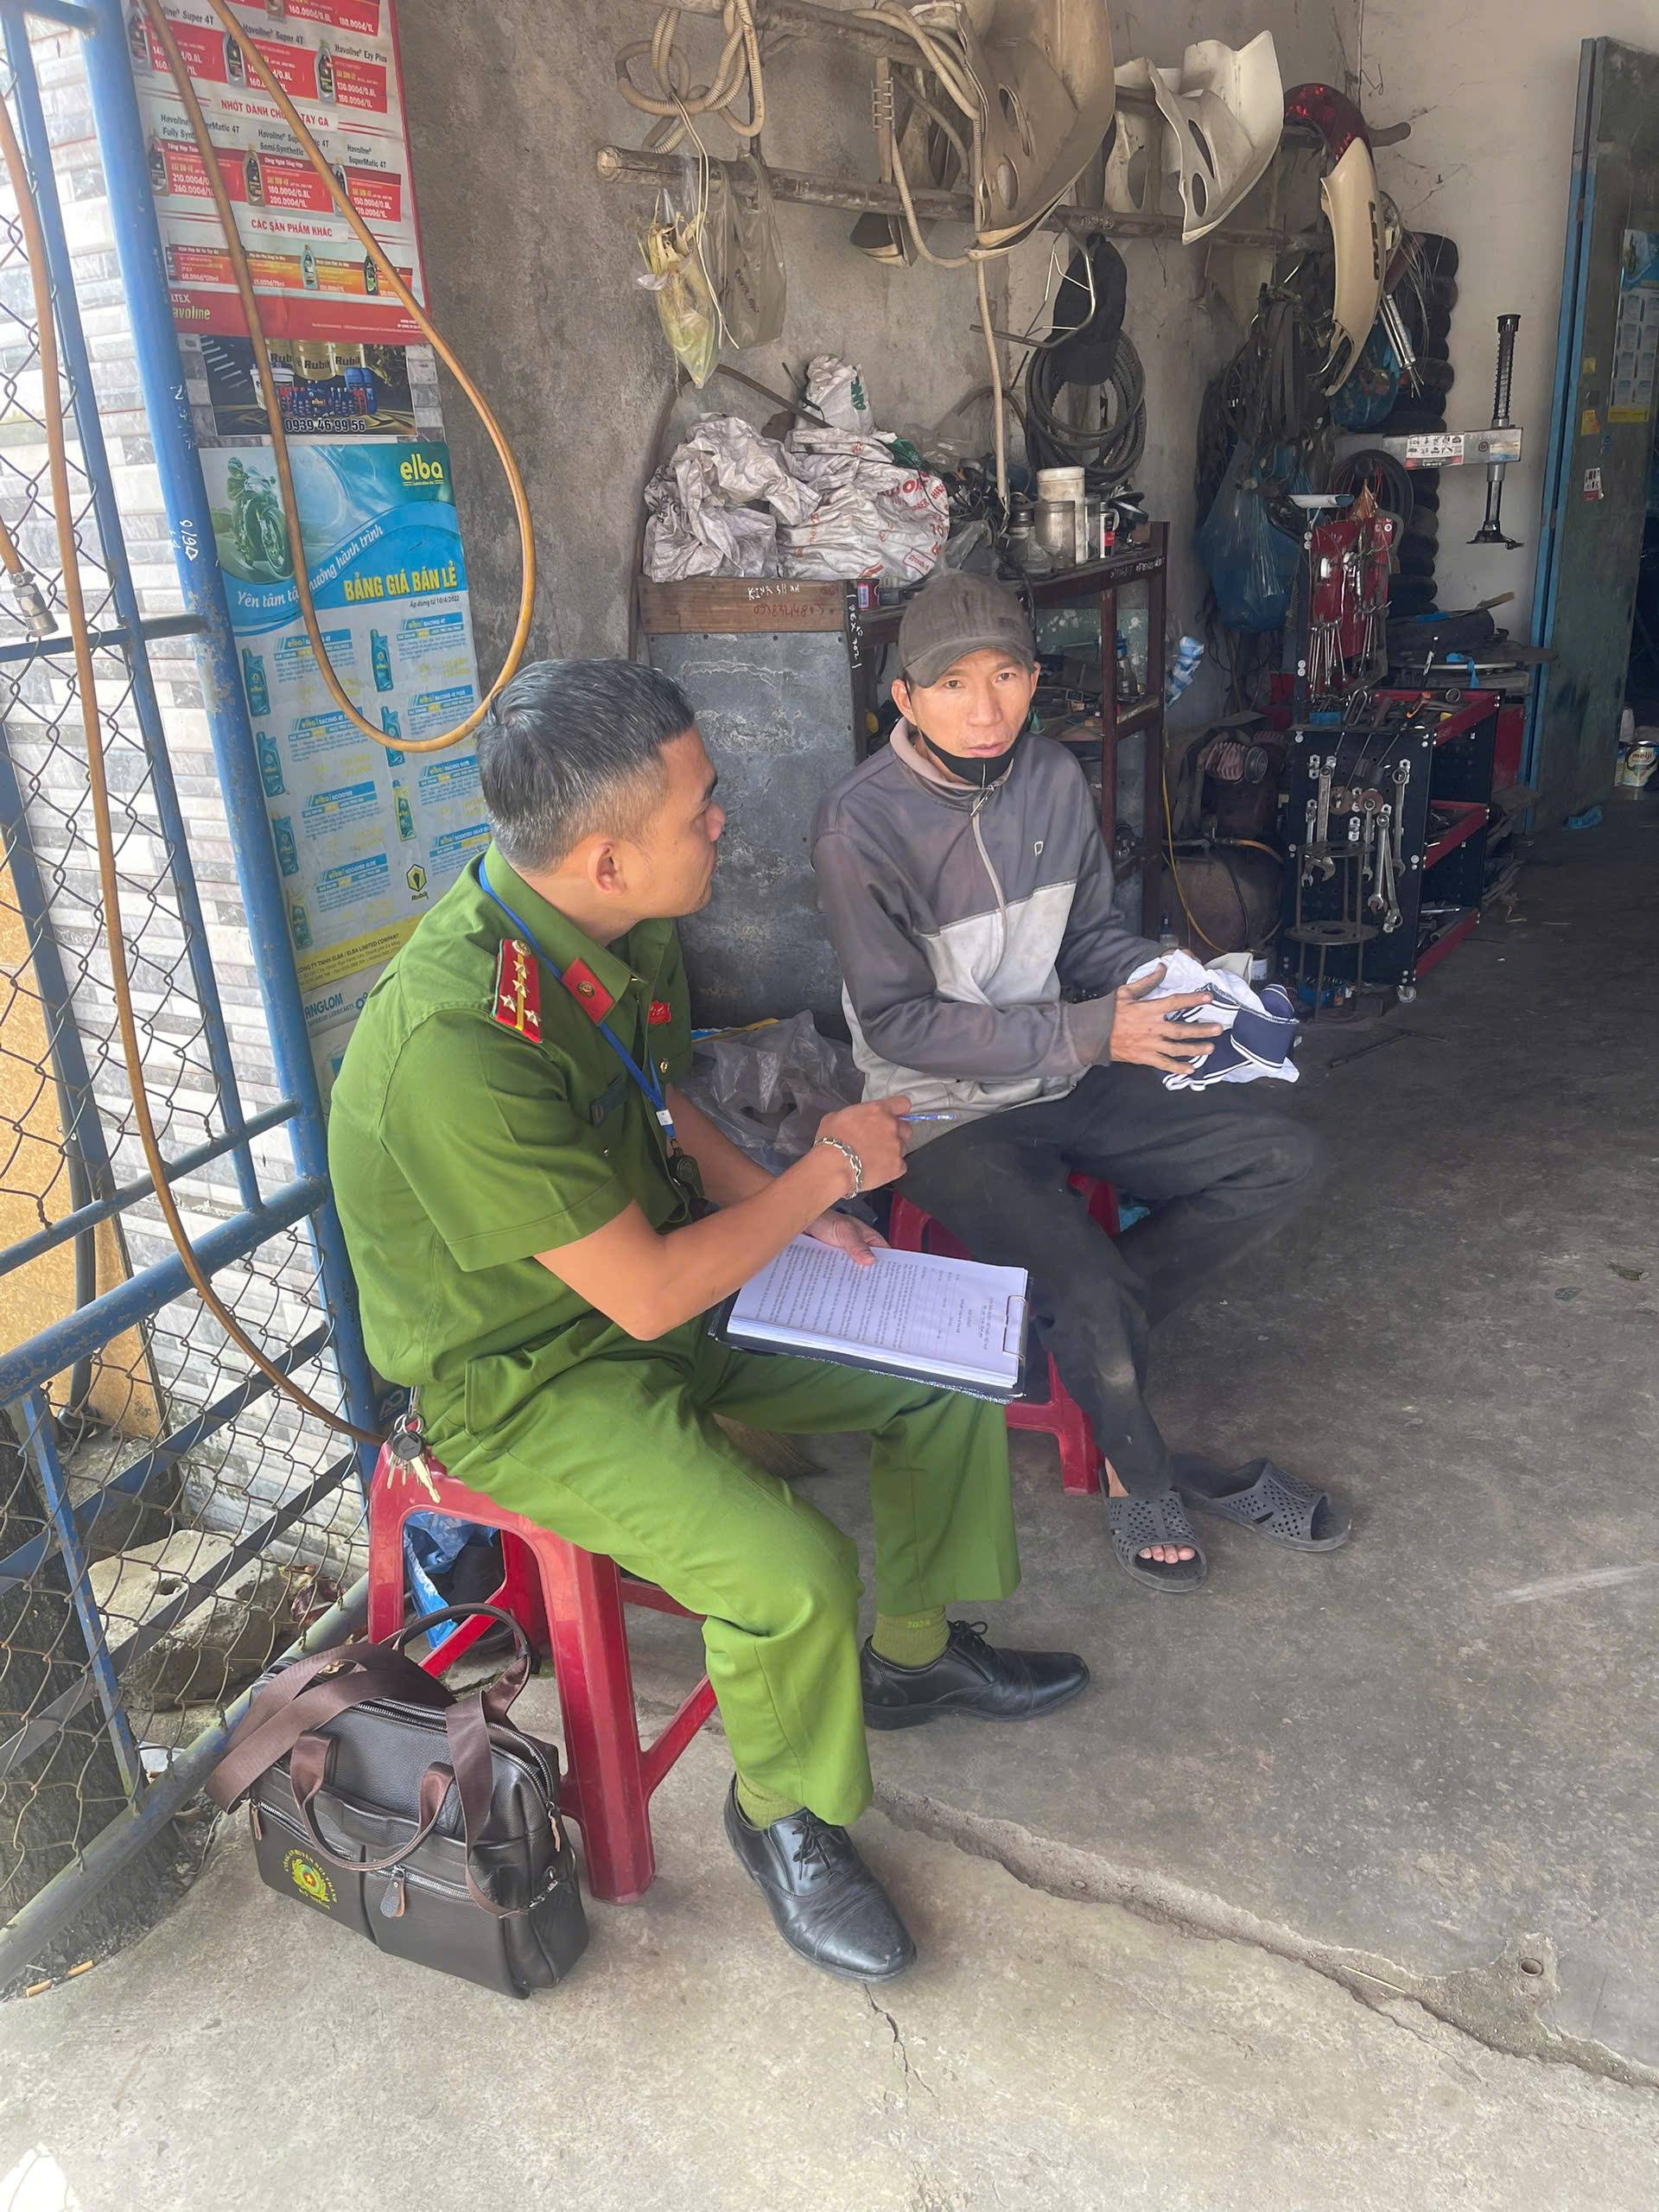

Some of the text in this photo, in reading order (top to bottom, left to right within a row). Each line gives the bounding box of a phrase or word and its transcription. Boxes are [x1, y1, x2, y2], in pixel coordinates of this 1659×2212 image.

[182, 10, 203, 23] Super
[205, 16, 214, 25] 4T
[276, 30, 294, 43] Super
[296, 35, 304, 45] 4T
[375, 54, 387, 64] Plus
[318, 117, 329, 127] GA
[162, 127, 179, 138] Fully
[232, 125, 239, 134] 4T
[321, 140, 329, 149] 4T
[348, 156, 387, 169] SuperMatic 4T
[171, 294, 190, 303] LTEX
[173, 305, 211, 321] avoline
[284, 418, 365, 433] 0939 46 99 56
[400, 454, 444, 480] elba
[238, 590, 259, 608] Yên
[263, 589, 285, 607] tâm
[335, 543, 360, 570] hành
[360, 524, 385, 548] trình
[343, 559, 458, 603] BẢNG GIÁ BÁN LẺ
[1631, 750, 1651, 760] meiji
